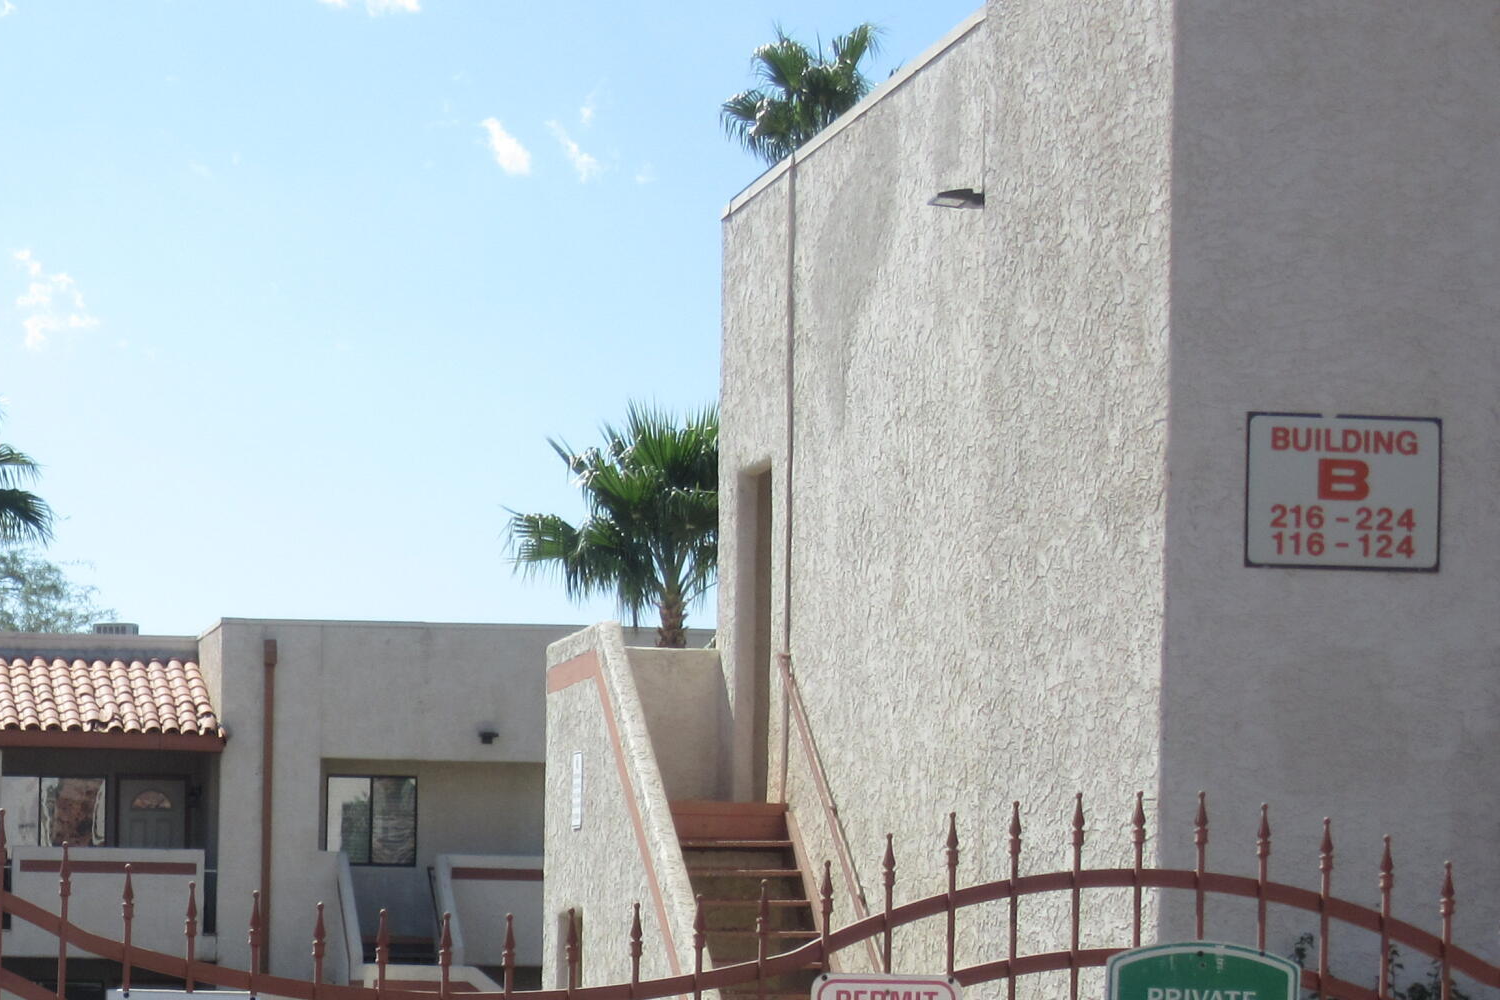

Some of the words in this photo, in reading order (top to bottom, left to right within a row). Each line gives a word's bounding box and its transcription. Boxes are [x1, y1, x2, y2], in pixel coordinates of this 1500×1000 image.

[1271, 427, 1419, 456] BUILDING
[1317, 458, 1370, 501] B
[1270, 504, 1325, 530] 216
[1356, 506, 1416, 531] 224
[1271, 532, 1325, 556] 116
[1358, 534, 1415, 559] 124
